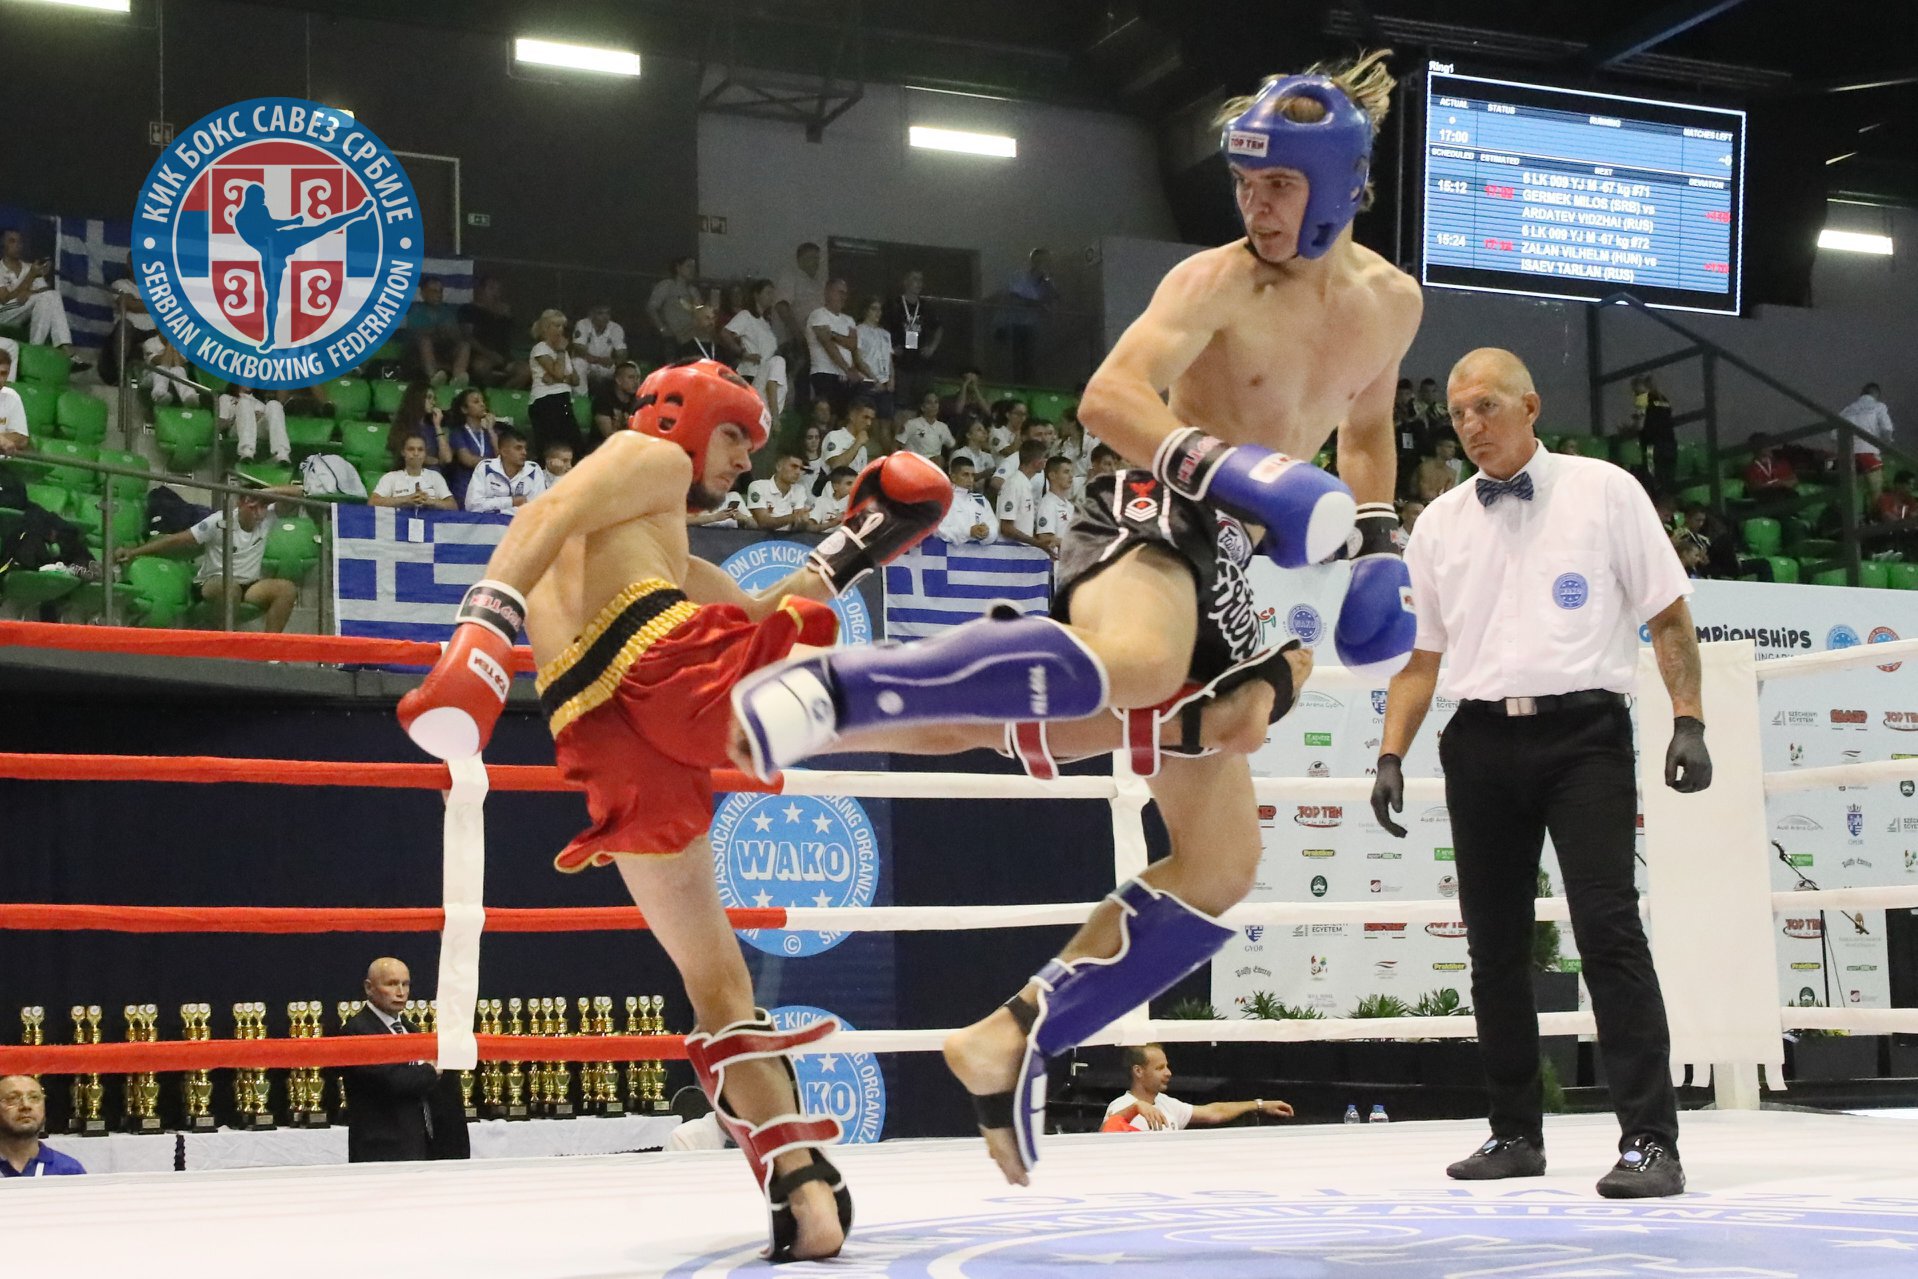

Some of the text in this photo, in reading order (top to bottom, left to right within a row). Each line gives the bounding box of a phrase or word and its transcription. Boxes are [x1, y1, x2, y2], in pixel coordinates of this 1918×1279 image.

[1428, 60, 1454, 74] Ring1
[1440, 98, 1468, 109] ACTUAL
[1488, 103, 1515, 114] STATUS
[1440, 129, 1468, 143] 17:00
[1716, 132, 1733, 142] LEFT
[1431, 148, 1475, 160] SCHEDULED
[1480, 154, 1520, 165] ESTIMATED
[1438, 180, 1467, 194] 15:12
[1523, 172, 1530, 184] 6
[1532, 173, 1548, 185] LK
[1550, 175, 1569, 188] 009
[1571, 178, 1585, 189] YJ
[1587, 180, 1597, 191] M
[1617, 183, 1631, 197] kg
[1632, 184, 1650, 197] #71
[1523, 189, 1655, 215] GERMEK MILOS (SRB) vs
[1522, 206, 1575, 223] ARDATEV
[1623, 217, 1654, 233] (RUS)
[1437, 234, 1466, 247] 15:24
[1521, 225, 1650, 250] 6 LK 009 YJ M -67 kg #72
[1521, 242, 1657, 267] ZALAN VILHELM (HUN) vs
[1521, 258, 1635, 283] ISAEV TARLAN (RUS)
[752, 547, 768, 565] OF
[1885, 711, 1904, 723] TOP
[1297, 806, 1342, 818] TOP TEN
[711, 791, 758, 884] ASSOCIATION
[735, 840, 850, 882] WAKO
[1785, 919, 1804, 930] TOP
[805, 1081, 857, 1121] KO
